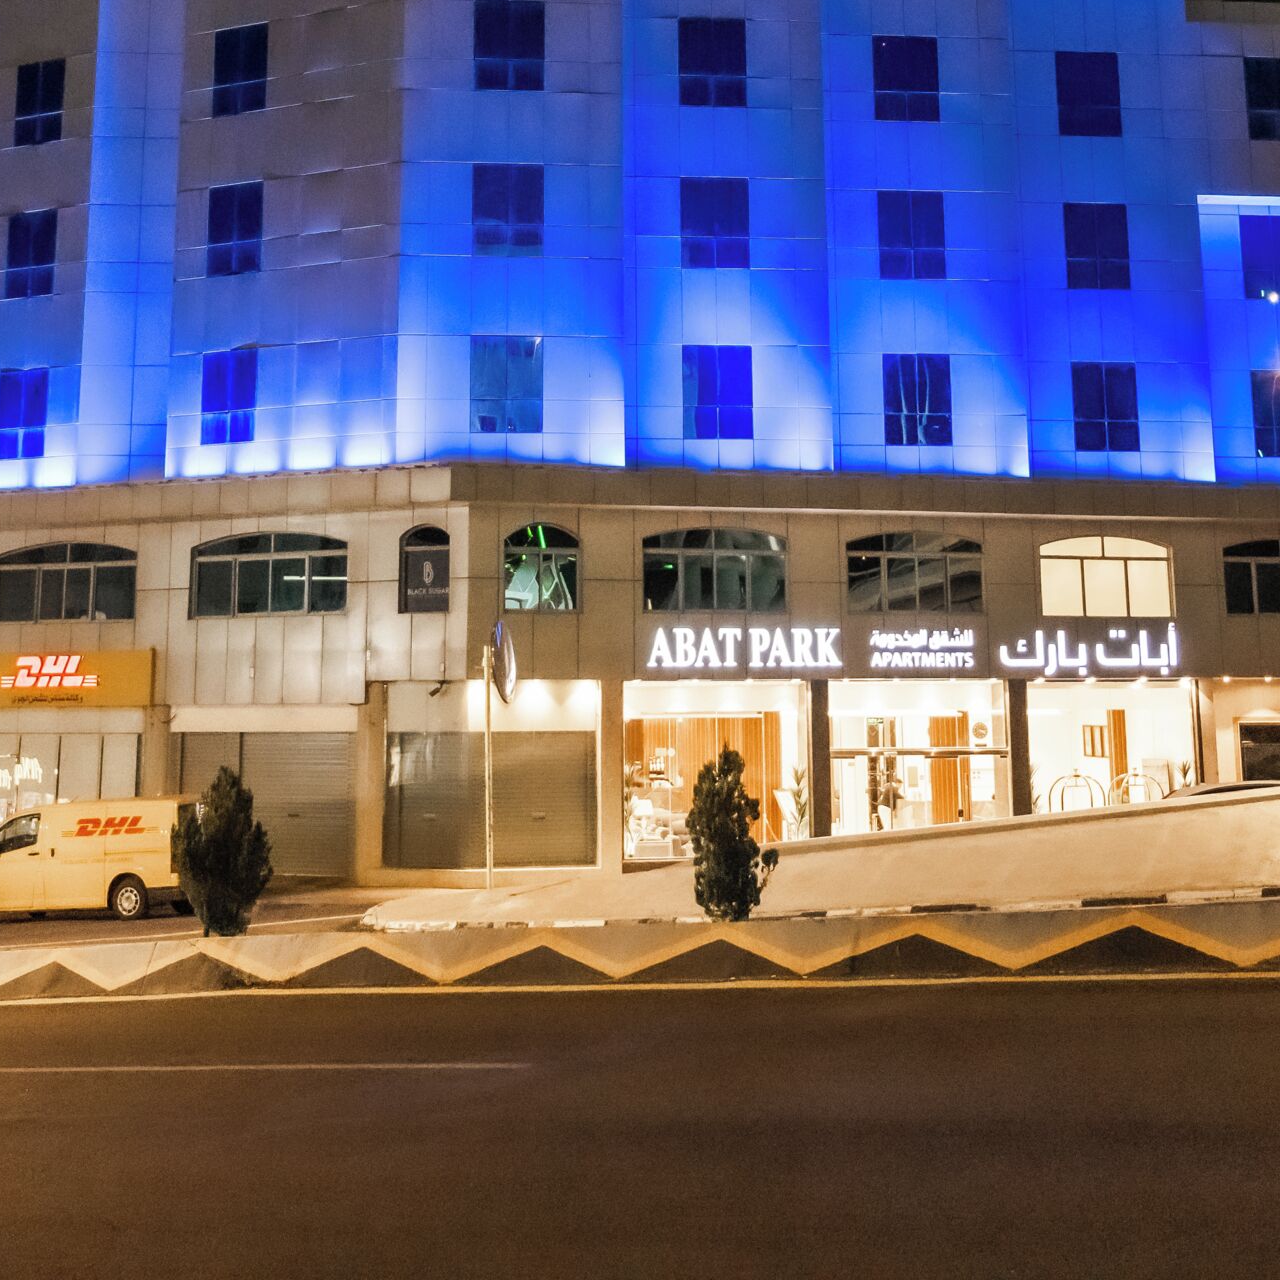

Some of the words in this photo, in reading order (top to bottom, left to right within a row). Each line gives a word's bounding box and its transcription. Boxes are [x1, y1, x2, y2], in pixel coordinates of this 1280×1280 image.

[407, 587, 427, 595] BLACK
[646, 627, 742, 667] ABAT
[748, 627, 843, 667] PARK
[870, 651, 974, 668] APARTMENTS
[999, 629, 1087, 676] بارك
[1095, 622, 1178, 675] أبات
[14, 655, 84, 687] DHL
[74, 816, 146, 837] DHL
